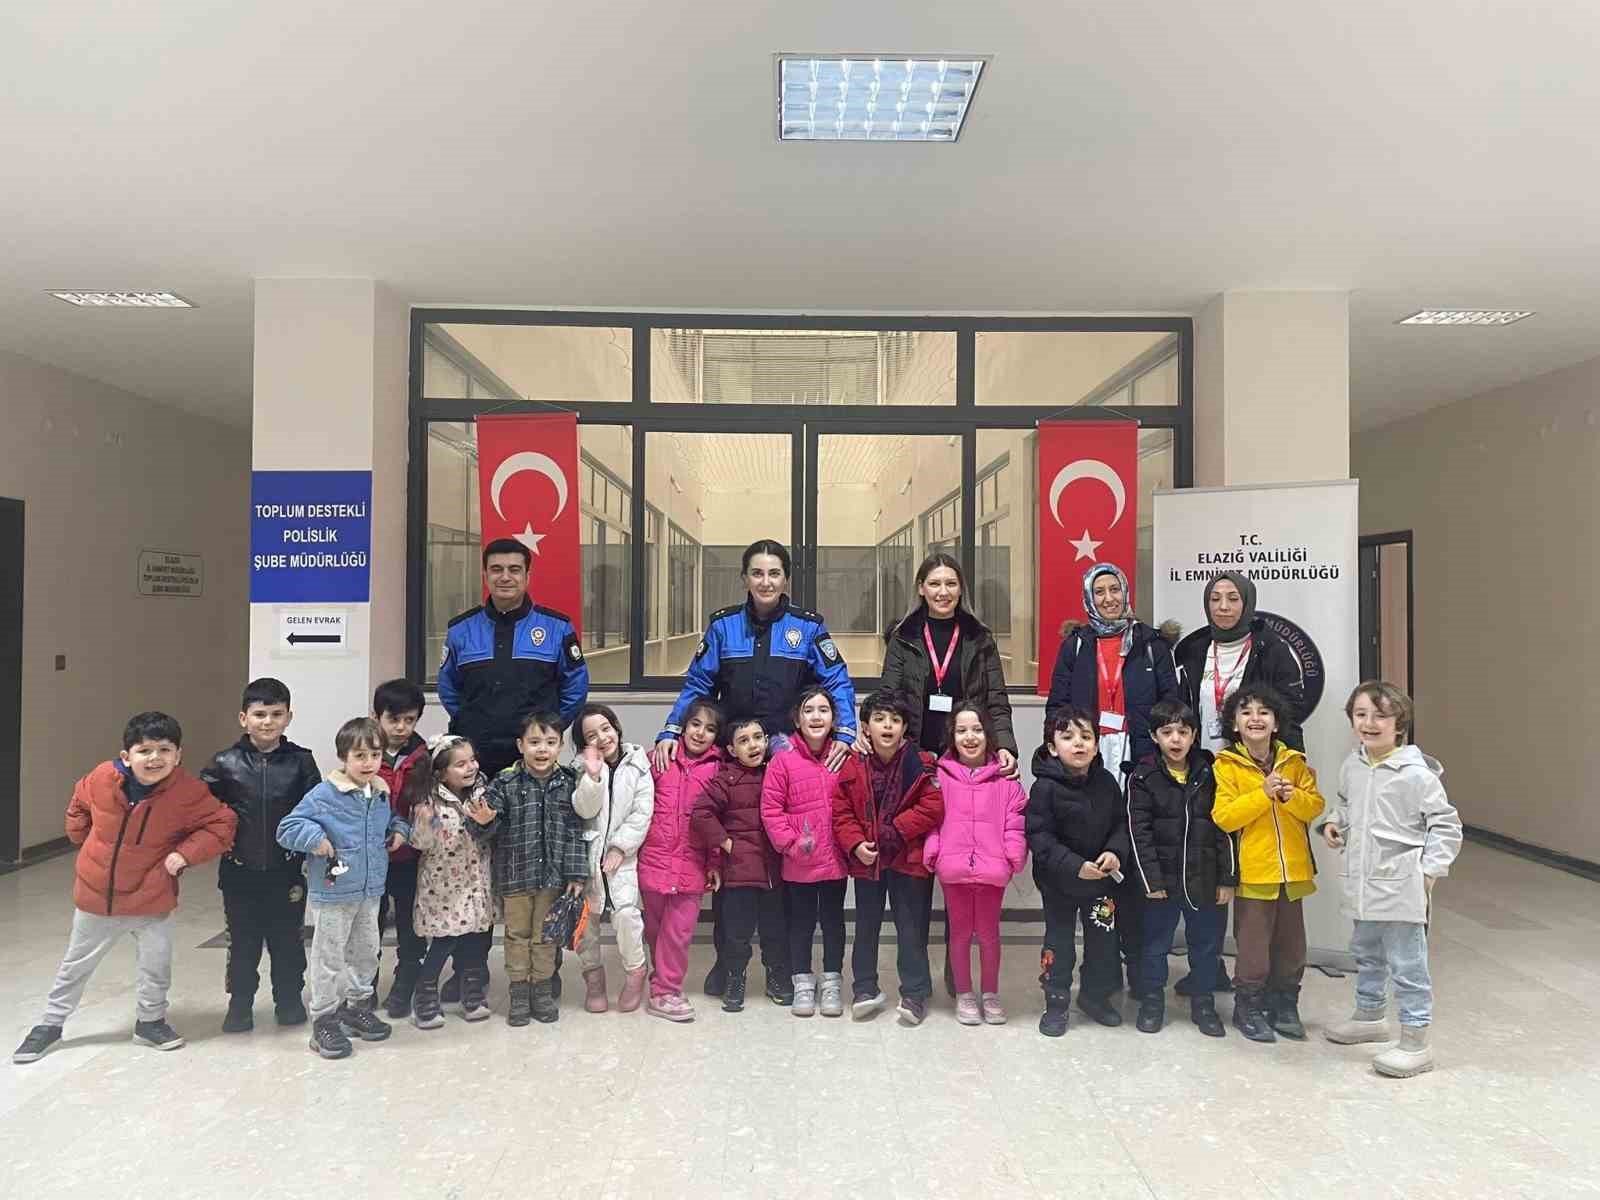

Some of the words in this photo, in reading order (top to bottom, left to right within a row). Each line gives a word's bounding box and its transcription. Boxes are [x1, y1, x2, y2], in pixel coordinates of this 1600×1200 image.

[255, 504, 305, 518] TOPLUM
[307, 501, 366, 518] DESTEKLİ
[283, 526, 338, 543] POLİSLİK
[1239, 534, 1263, 546] T.C.
[254, 554, 287, 571] ŞUBE
[290, 551, 367, 568] MÜDÜRLÜĞÜ
[1197, 549, 1245, 564] ELAZIĞ
[1248, 548, 1307, 563] VALİLİĞİ
[1170, 567, 1182, 582] İL
[1185, 567, 1244, 582] EMNİ
[1247, 564, 1339, 581] MÜDÜRLÜĞÜ
[286, 616, 313, 625] GELEN
[314, 616, 341, 624] EVRAK
